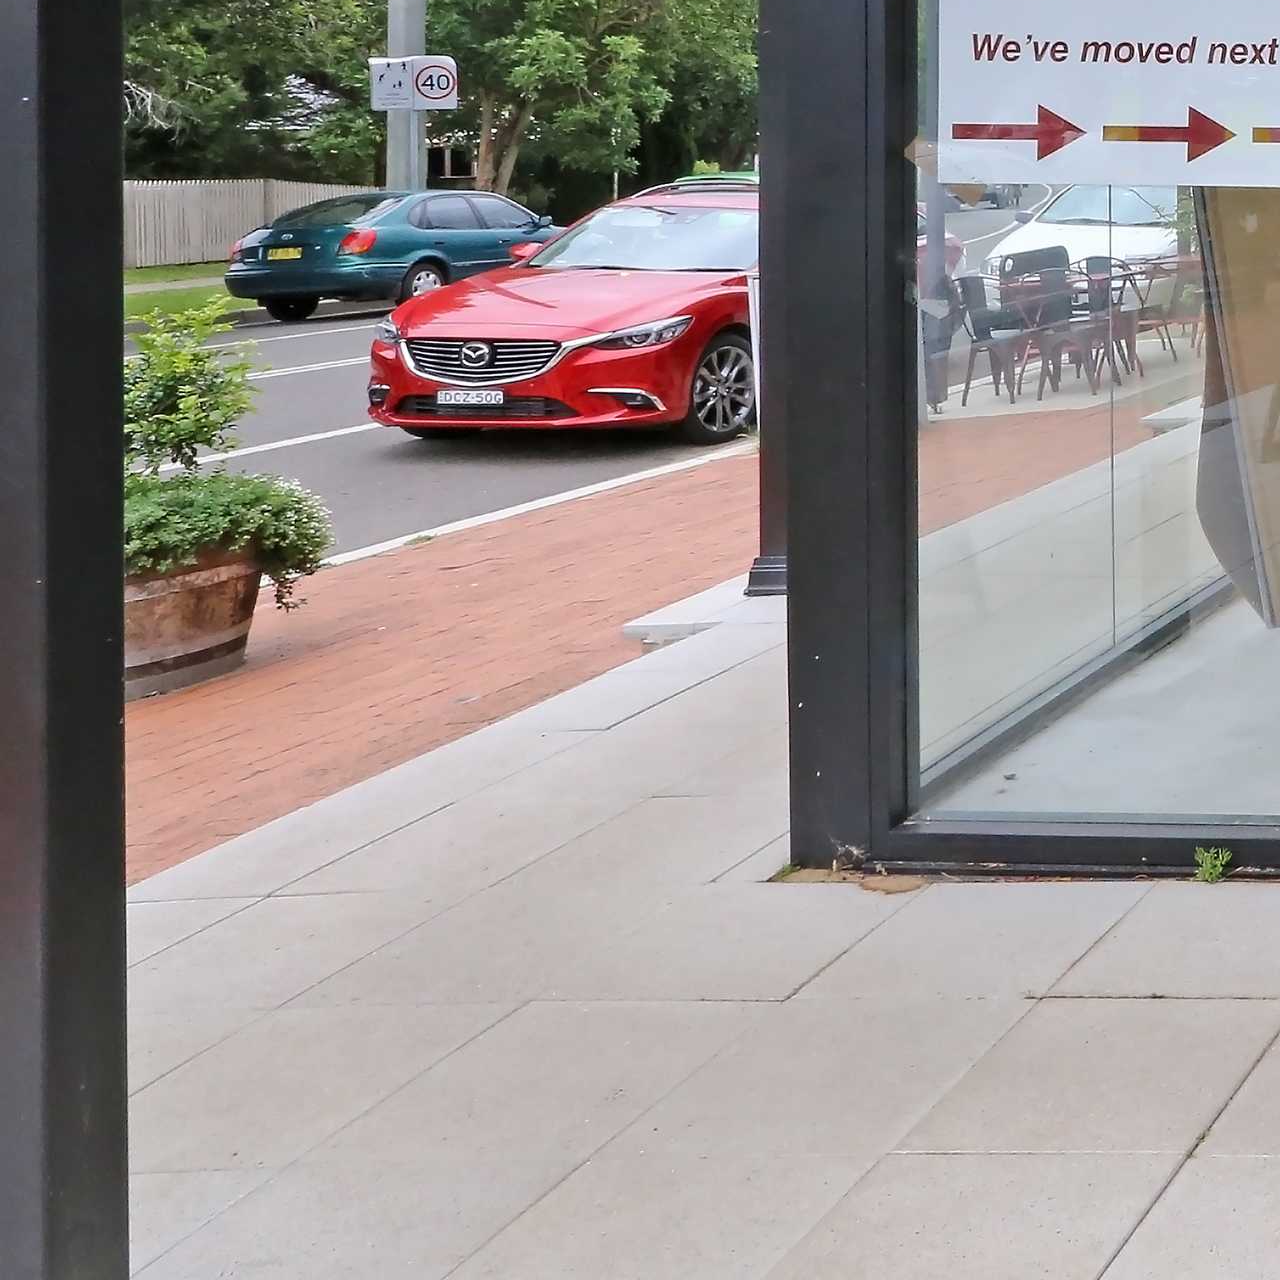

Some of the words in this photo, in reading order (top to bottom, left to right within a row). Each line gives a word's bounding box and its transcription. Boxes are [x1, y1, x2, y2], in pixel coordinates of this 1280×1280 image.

[971, 33, 1069, 63] We've
[1080, 36, 1198, 64] moved
[1207, 39, 1279, 66] next
[421, 74, 451, 90] 40
